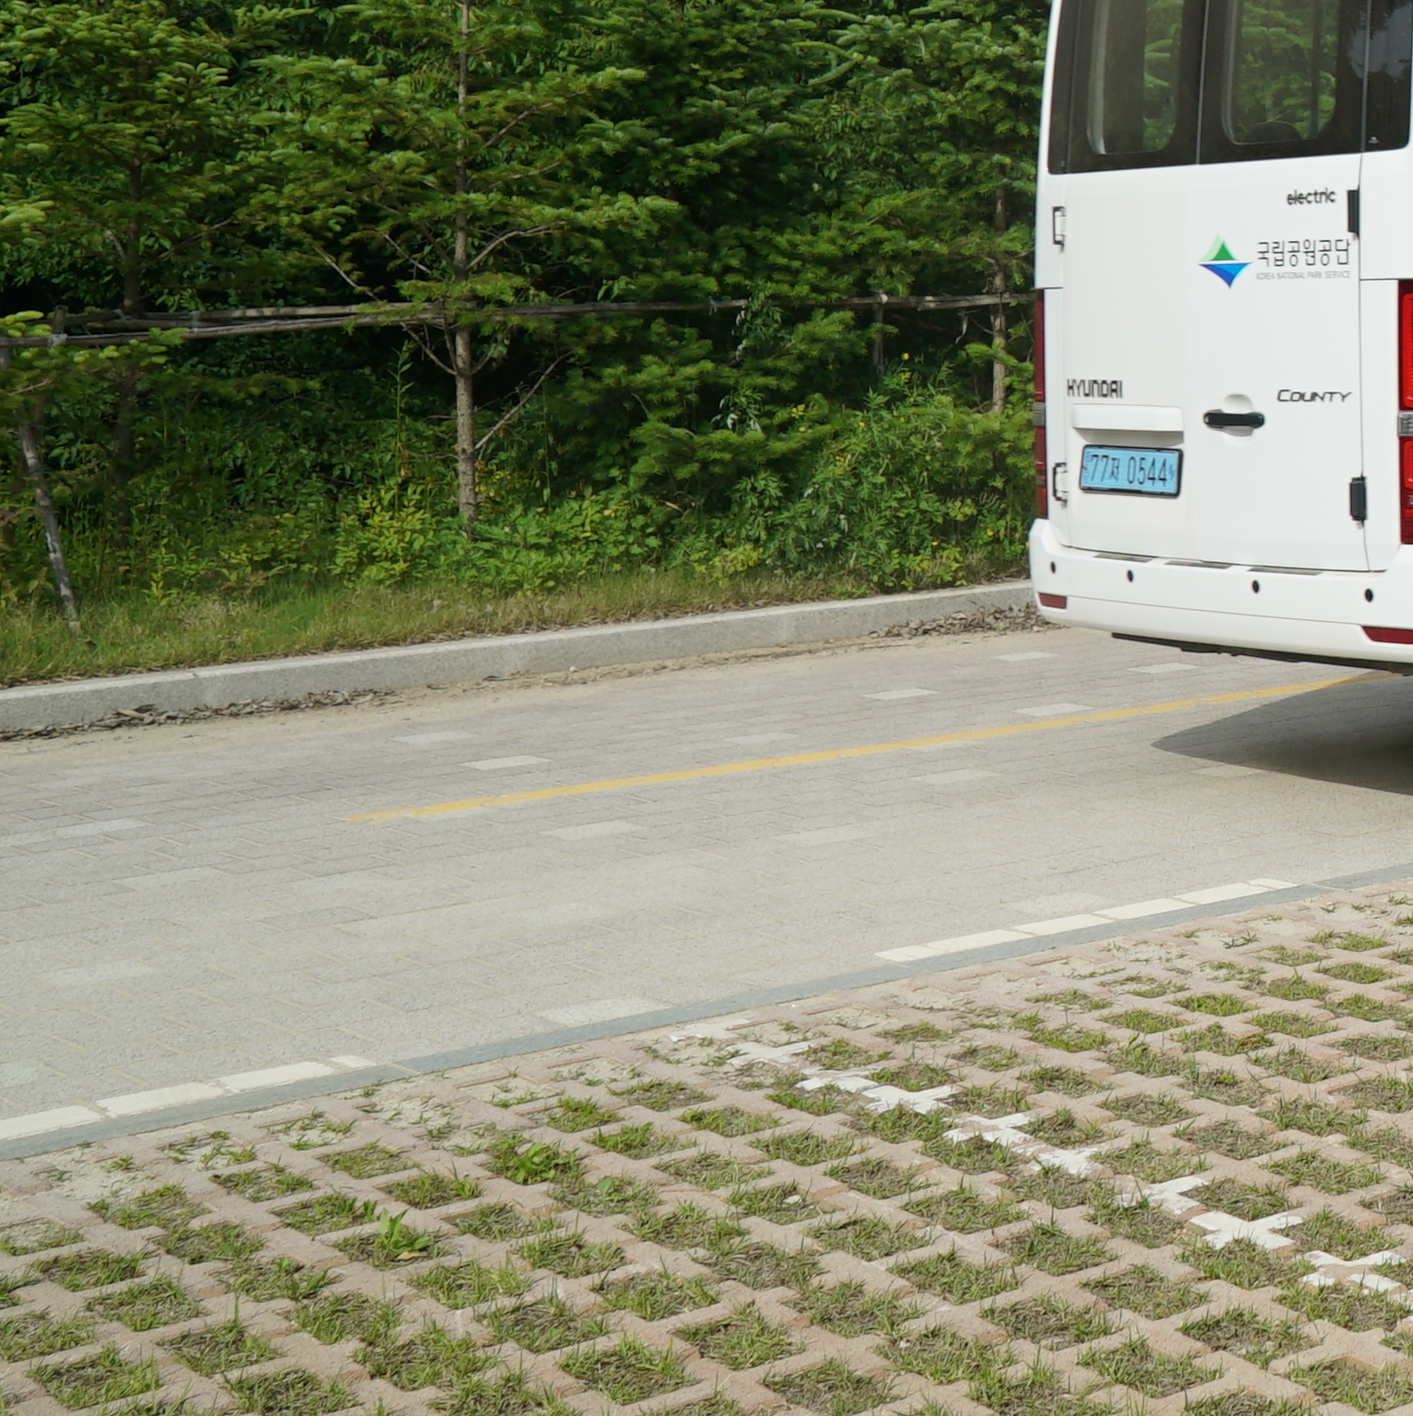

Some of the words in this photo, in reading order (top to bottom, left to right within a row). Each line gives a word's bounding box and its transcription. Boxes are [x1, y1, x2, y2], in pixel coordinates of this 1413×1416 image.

[1286, 187, 1337, 206] electric
[1256, 238, 1351, 268] 국립공원공단
[1276, 271, 1306, 280] NATIONAL
[1307, 270, 1323, 279] PARK
[1324, 270, 1351, 279] SERVICE
[1066, 378, 1124, 399] HYUNDAI
[1277, 389, 1353, 403] COUNTY
[1126, 456, 1168, 487] 0544
